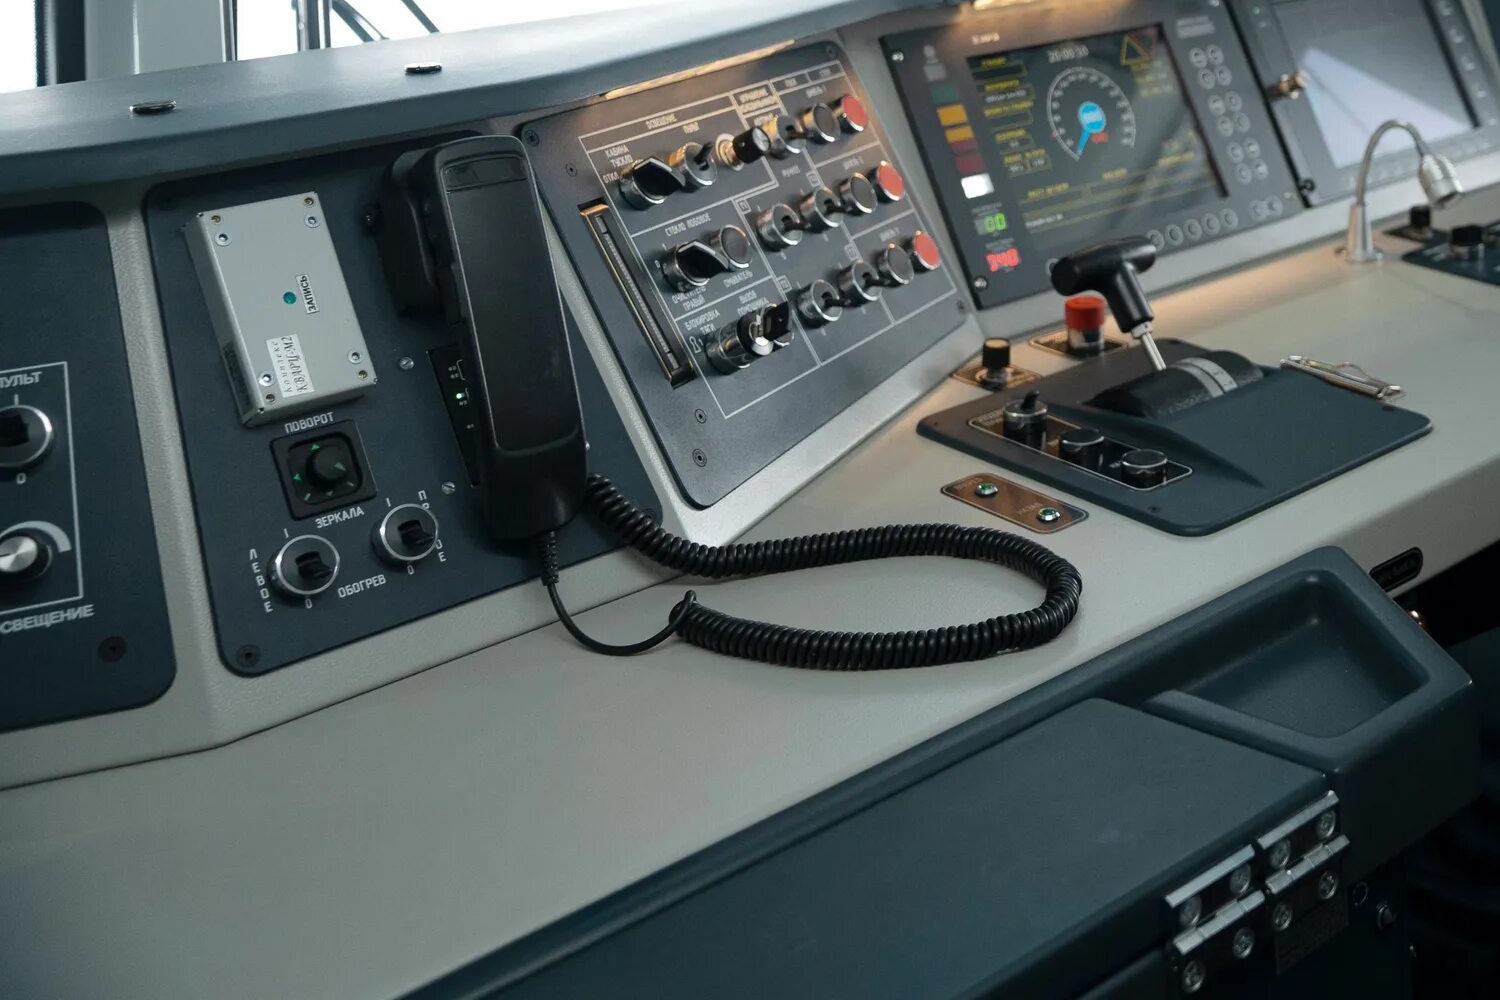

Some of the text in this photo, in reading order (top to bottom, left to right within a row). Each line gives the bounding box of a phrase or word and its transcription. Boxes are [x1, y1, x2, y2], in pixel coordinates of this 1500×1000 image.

[604, 144, 630, 158] КАБИНА
[299, 275, 317, 312] ЗАПИСЬ
[284, 411, 335, 434] ПОВОРОТ
[315, 506, 365, 529] ЗЕРКАЛА
[249, 548, 273, 613] ЛЕВОЕ
[337, 573, 387, 599] ОБОГРЕВ
